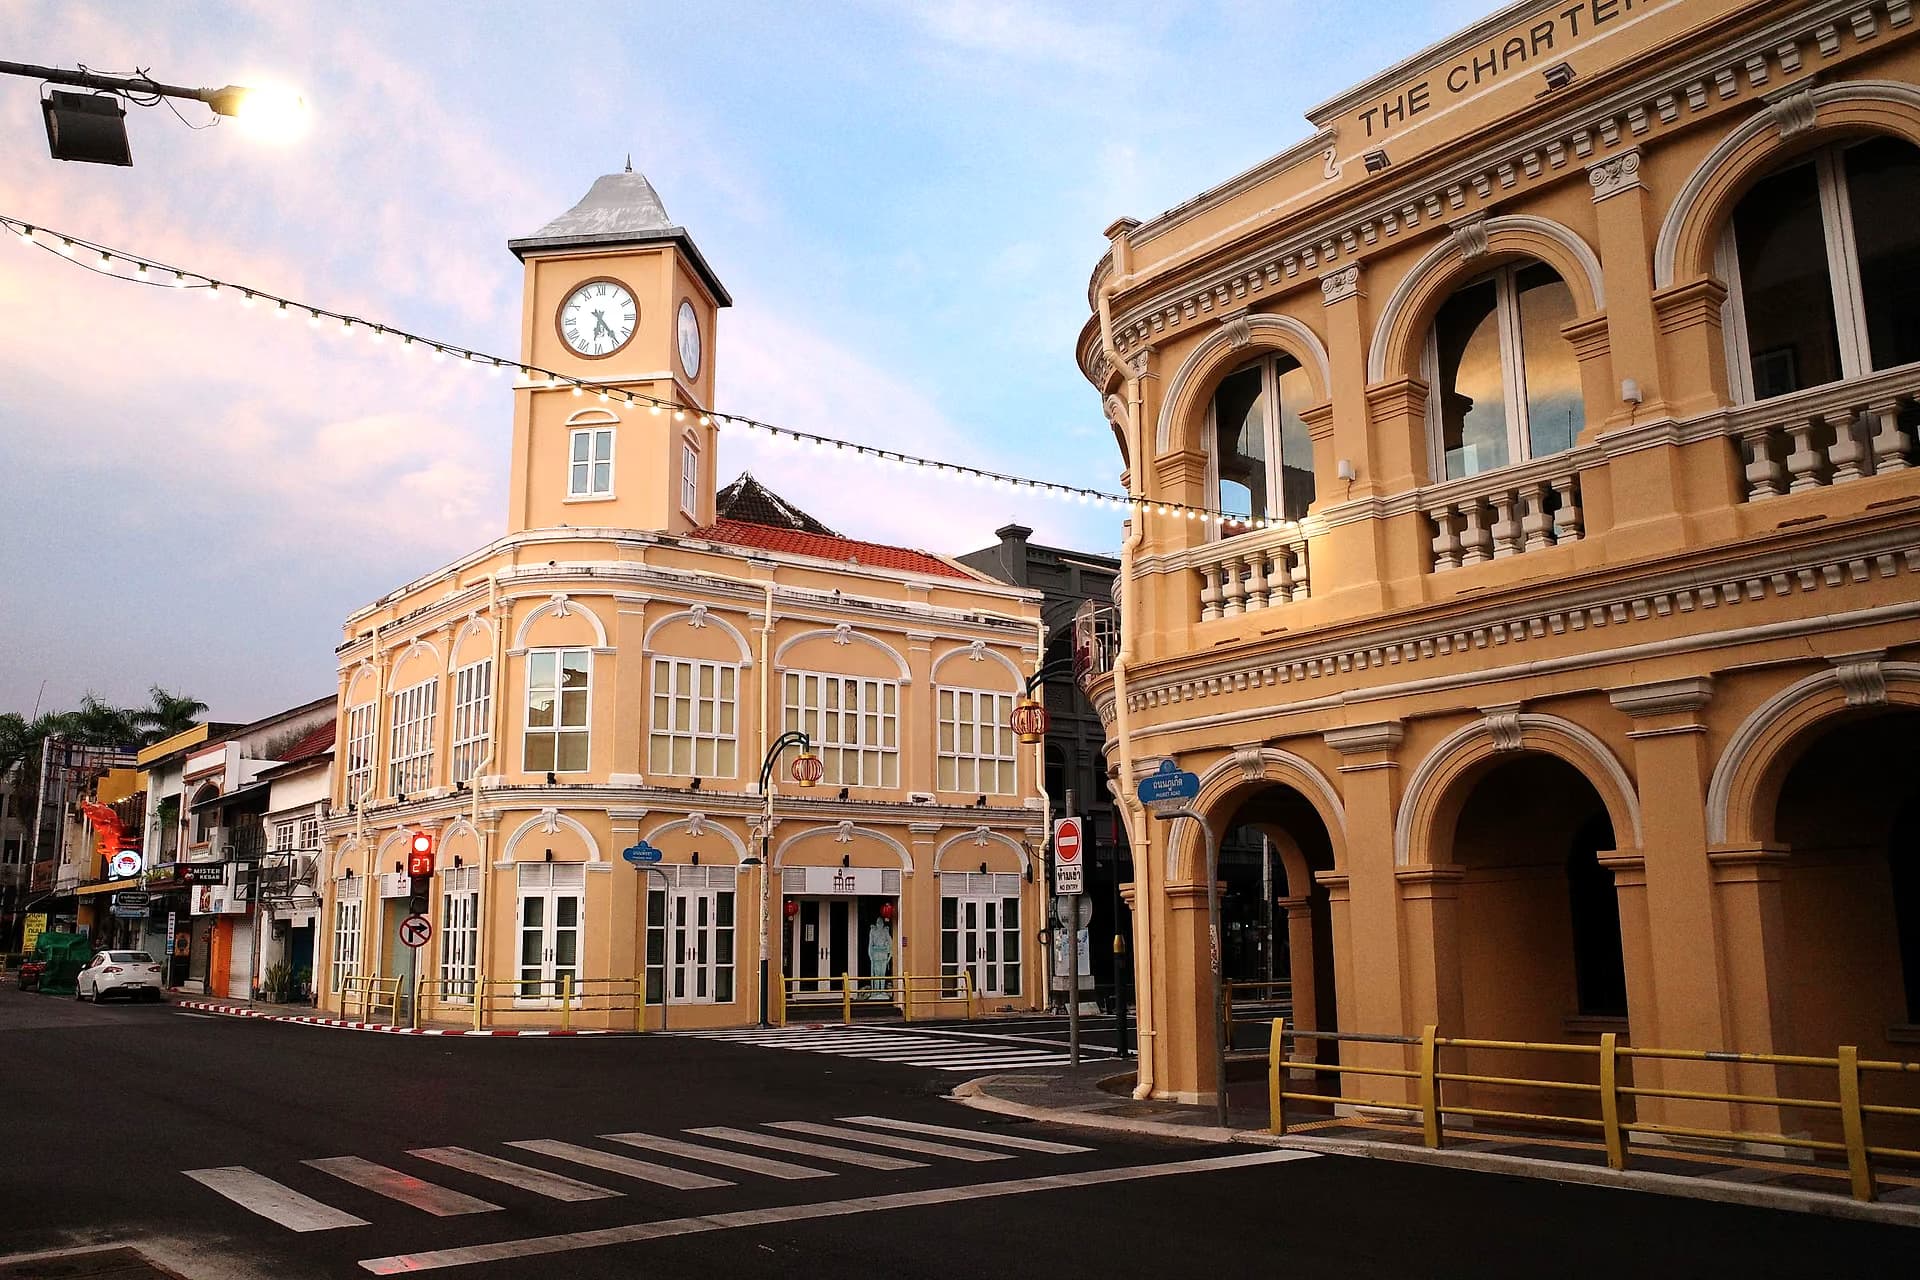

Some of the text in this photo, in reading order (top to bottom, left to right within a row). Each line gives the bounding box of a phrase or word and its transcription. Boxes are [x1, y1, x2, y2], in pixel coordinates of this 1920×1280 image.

[1358, 82, 1429, 137] THE
[412, 858, 430, 873] 27
[1057, 866, 1081, 881] ห้ามเข้า
